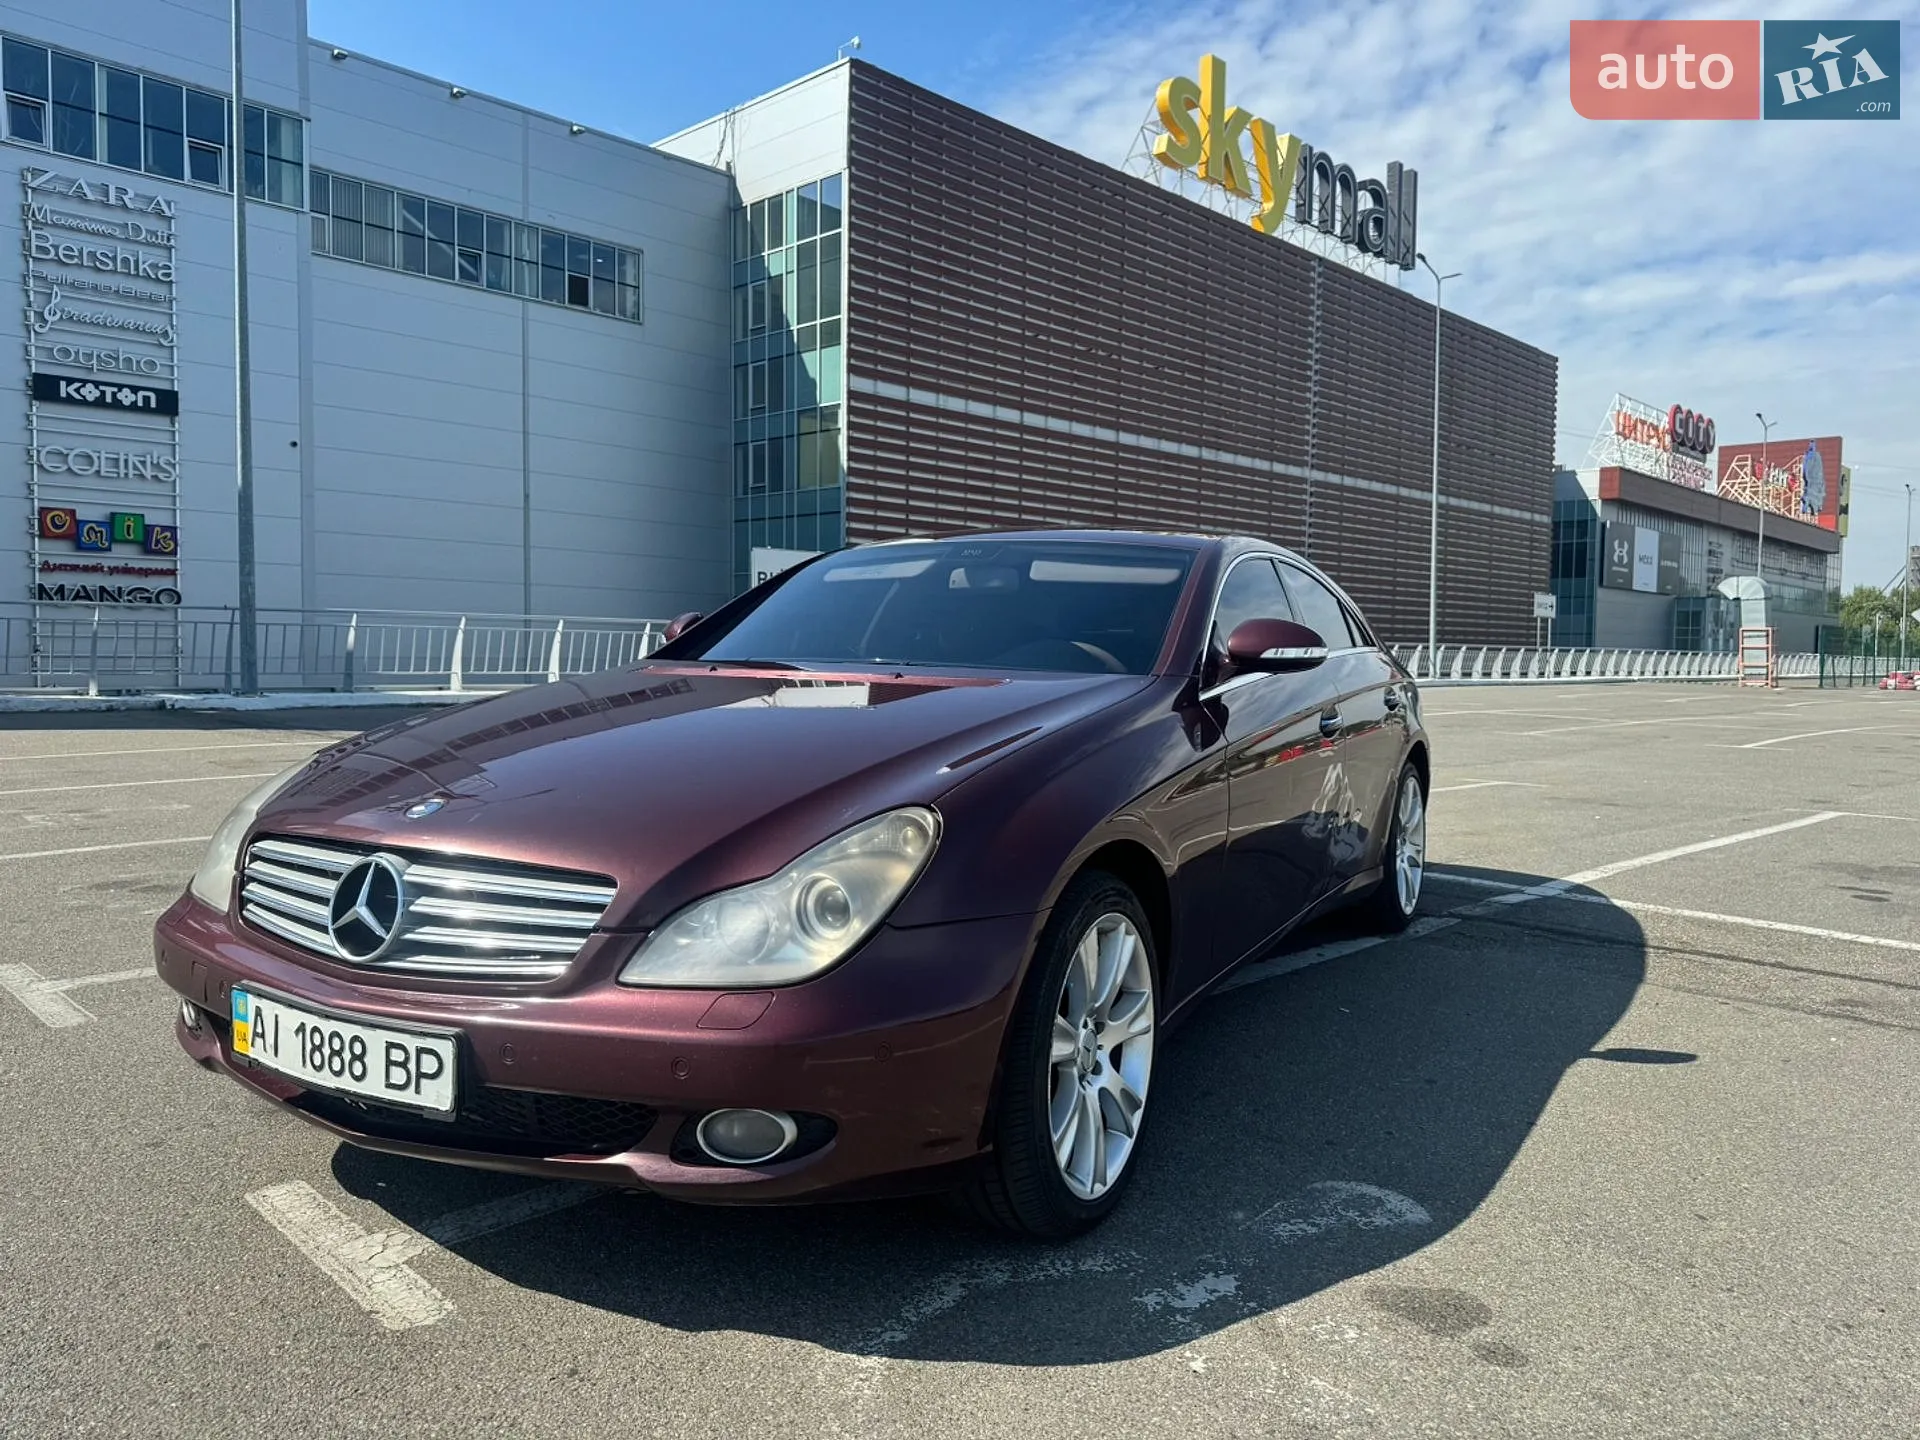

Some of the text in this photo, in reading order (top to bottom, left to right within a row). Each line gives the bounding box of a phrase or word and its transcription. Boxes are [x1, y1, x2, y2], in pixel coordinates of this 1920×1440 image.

[28, 170, 175, 217] ZARA
[28, 202, 119, 237] Massimo
[30, 230, 175, 282] Bershka
[39, 445, 177, 482] COLIN'S
[37, 583, 182, 605] MANGO
[251, 1005, 444, 1095] AI 1888 BP
